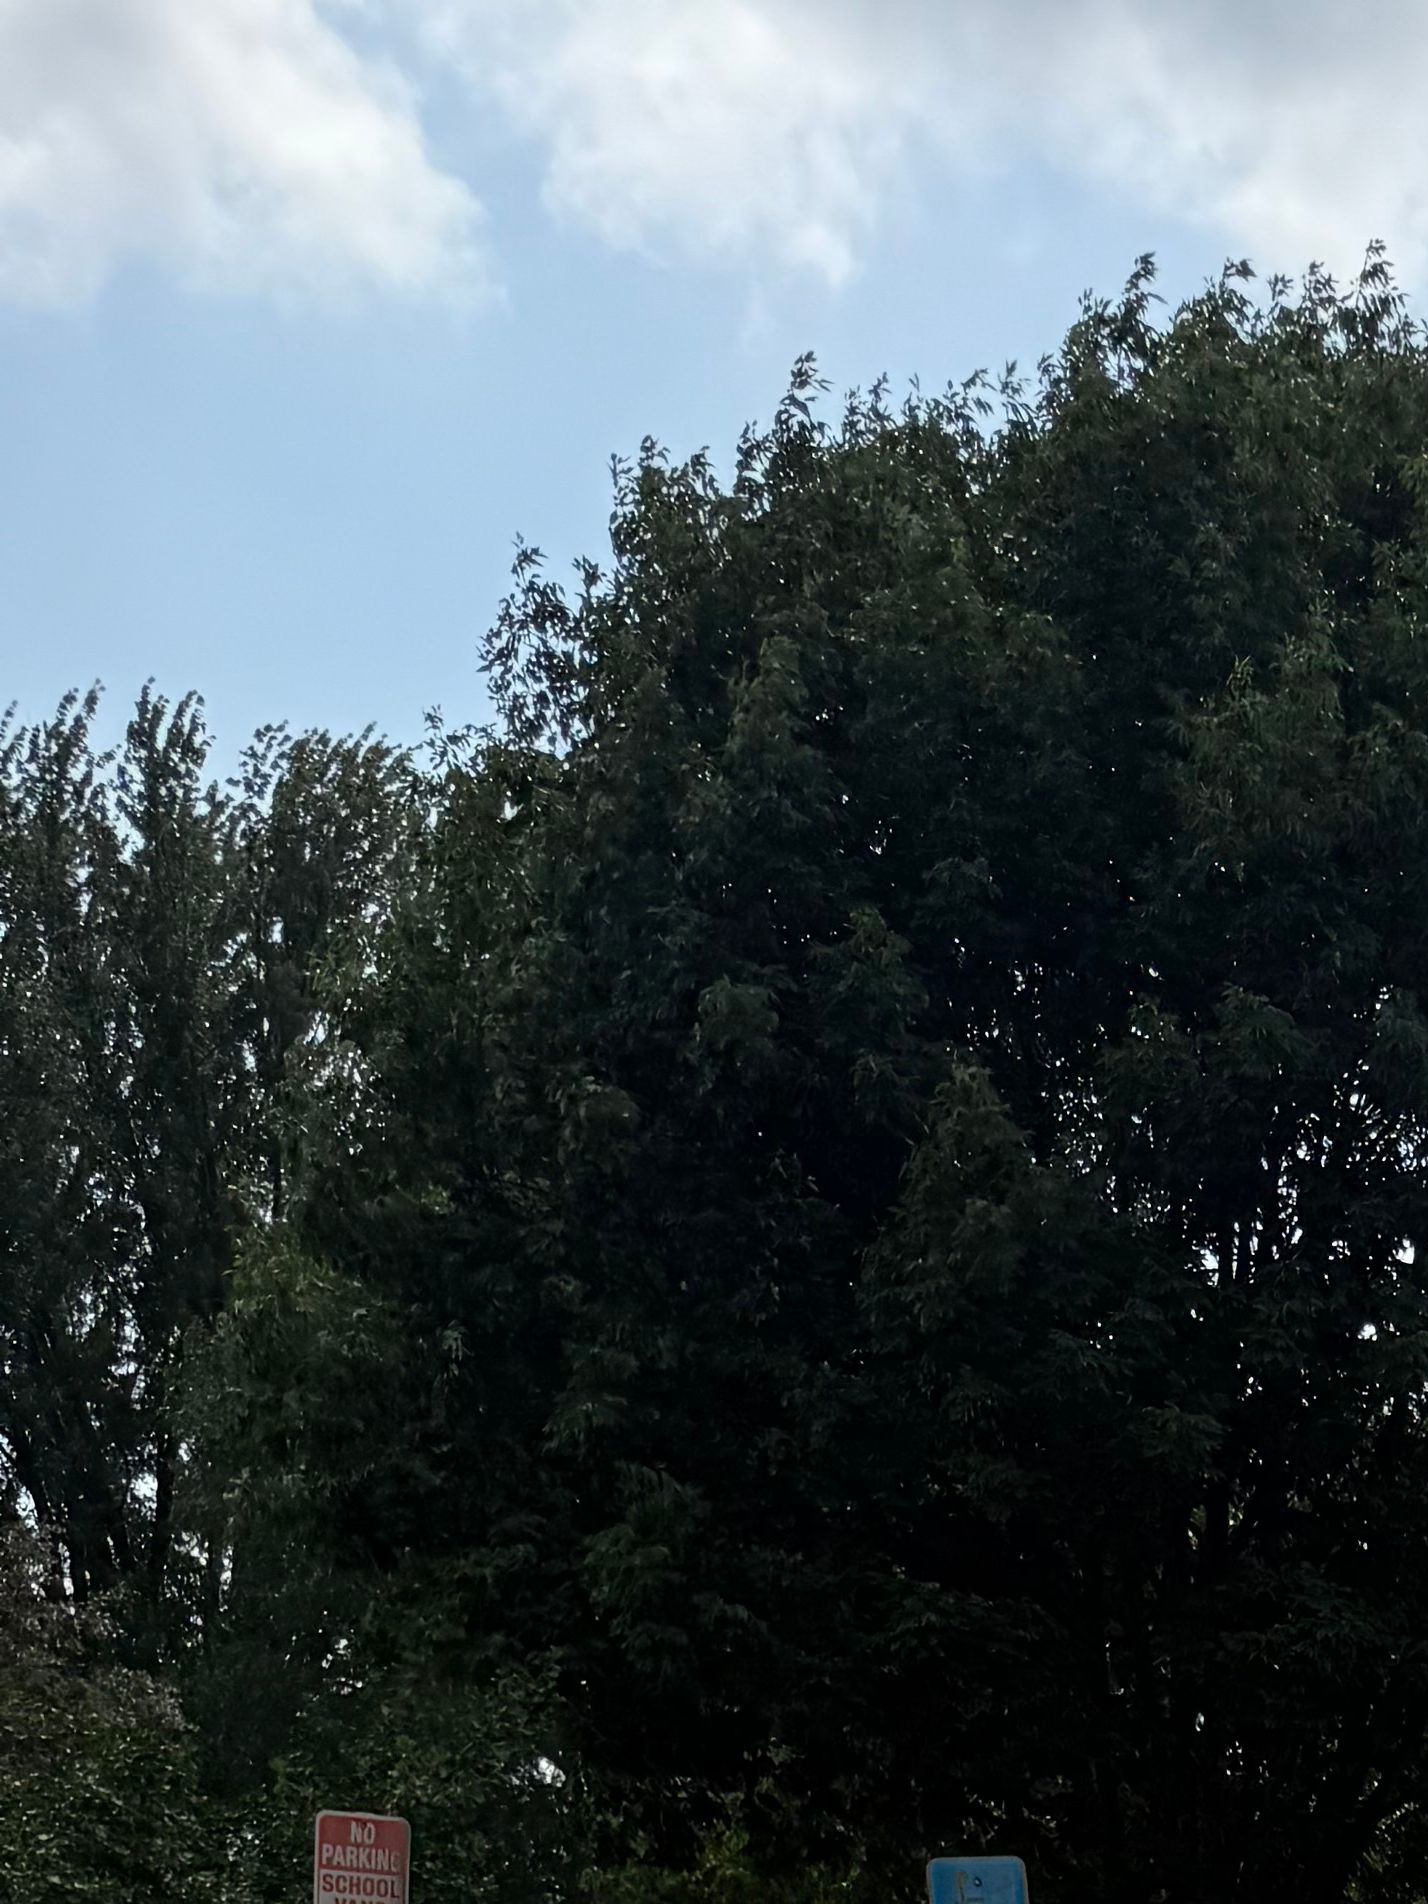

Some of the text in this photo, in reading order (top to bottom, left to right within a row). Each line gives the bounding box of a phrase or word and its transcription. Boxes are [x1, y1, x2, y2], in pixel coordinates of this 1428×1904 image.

[350, 1820, 376, 1845] NO
[321, 1843, 401, 1873] PARKING
[322, 1873, 401, 1899] SCHOOL
